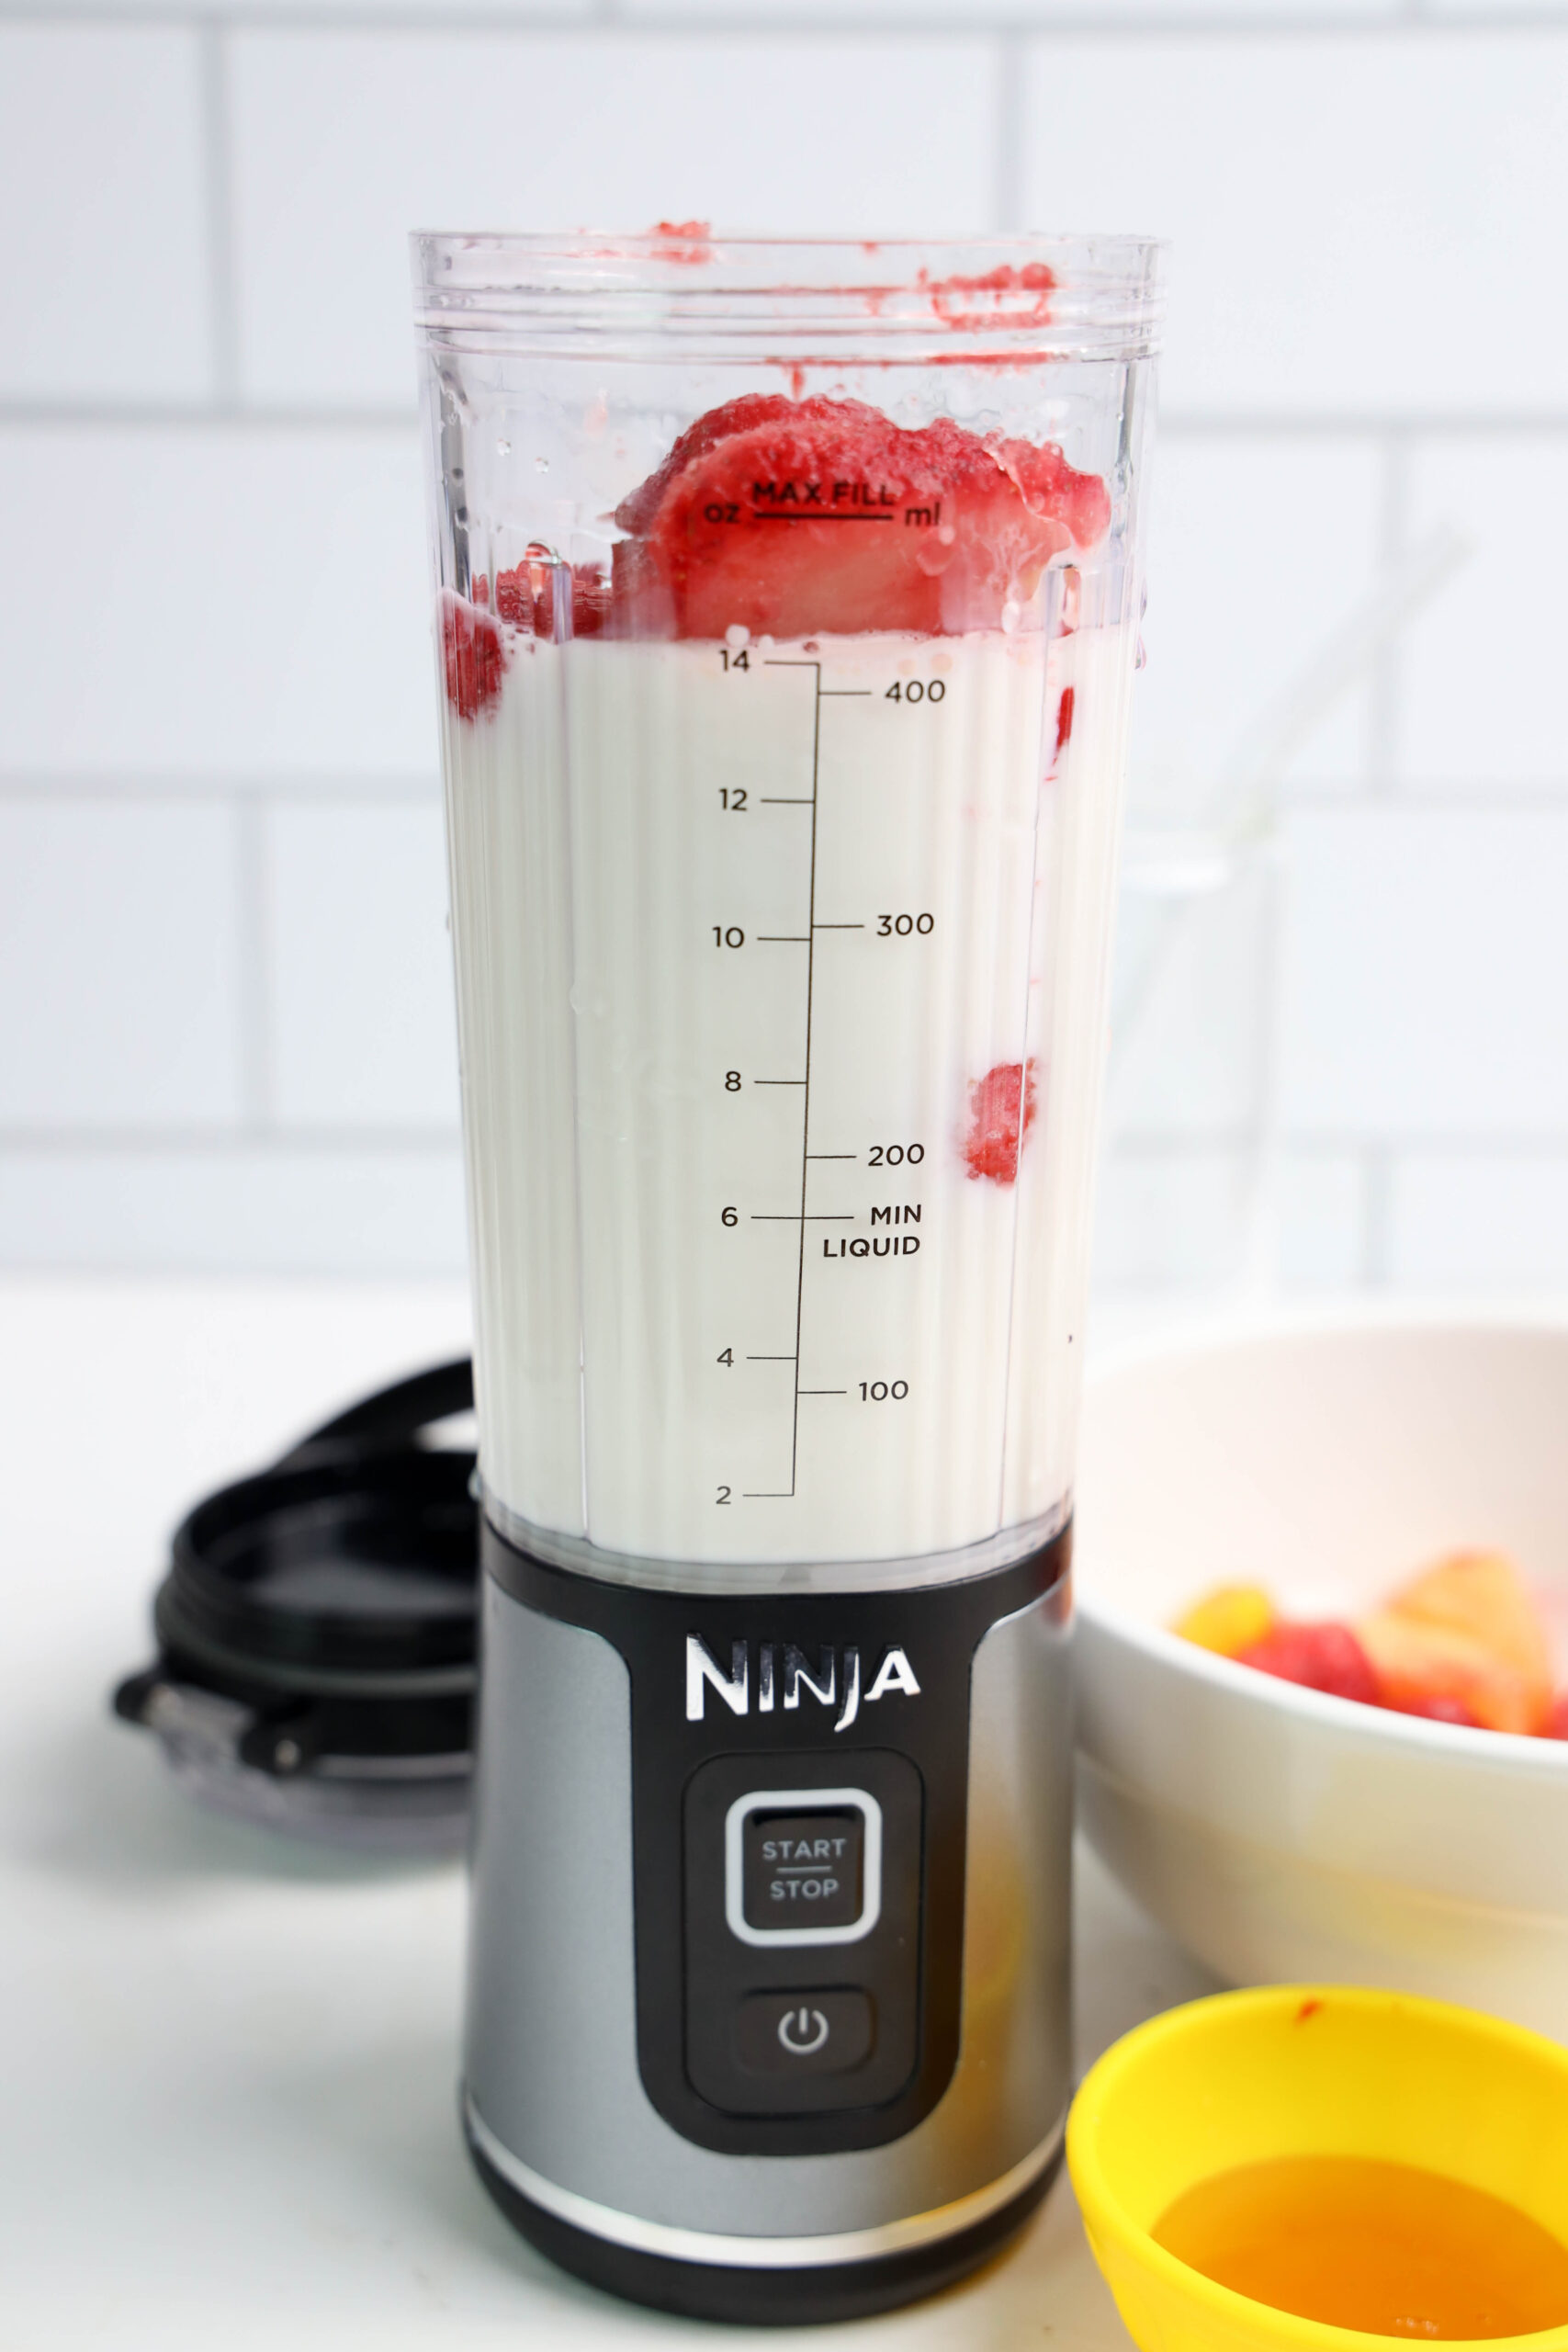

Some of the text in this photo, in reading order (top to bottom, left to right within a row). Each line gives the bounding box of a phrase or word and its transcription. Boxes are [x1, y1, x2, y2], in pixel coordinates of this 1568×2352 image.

[752, 481, 895, 505] MAX FILL
[704, 505, 740, 525] oz
[905, 502, 941, 526] ml
[719, 650, 750, 673] 14
[885, 680, 946, 703] 400
[718, 788, 748, 812] 12
[876, 912, 934, 936] 300
[712, 926, 745, 948] 10
[725, 1070, 741, 1092] 8
[867, 1143, 926, 1167] 200
[721, 1207, 739, 1227] 6
[871, 1204, 921, 1226] MIN
[823, 1237, 920, 1258] LIQUID
[716, 1348, 734, 1367] 4
[858, 1380, 909, 1401] 100
[716, 1486, 731, 1505] 2
[686, 1633, 920, 1733] NINJA
[762, 1838, 847, 1860] START
[770, 1879, 839, 1901] STOP
